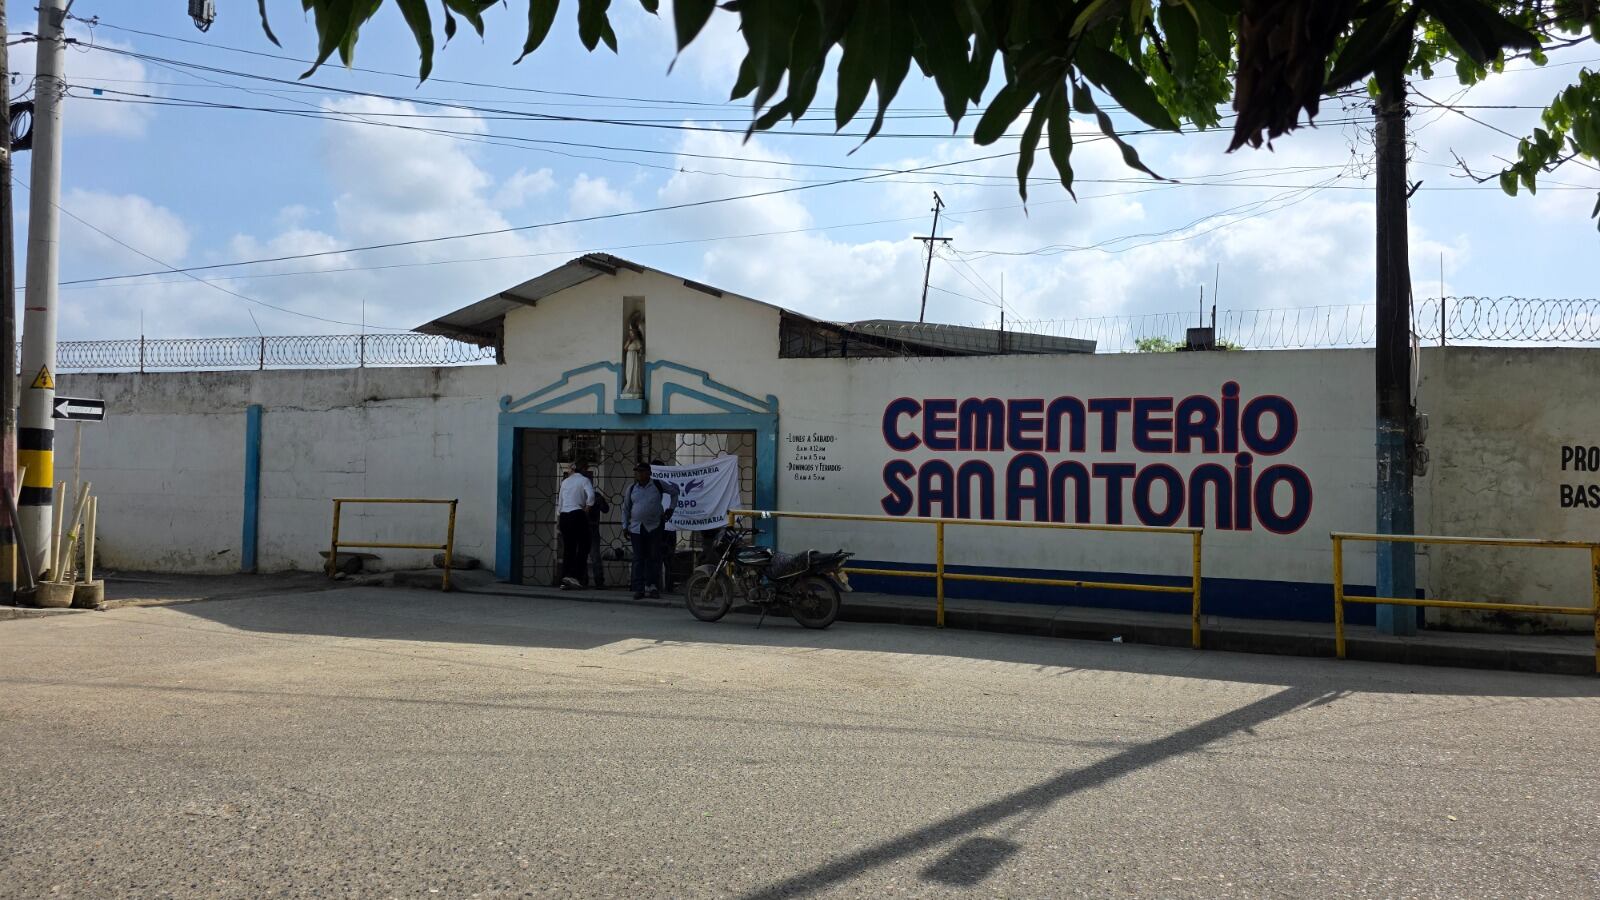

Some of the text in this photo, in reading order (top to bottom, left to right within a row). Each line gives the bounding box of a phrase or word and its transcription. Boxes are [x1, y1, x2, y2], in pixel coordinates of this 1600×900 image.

[882, 381, 1299, 456] CEMENTERIO
[1561, 445, 1600, 472] PRO
[670, 466, 720, 479] HUMANITARIA
[880, 451, 1313, 535] SAN ANTONIO
[676, 499, 697, 508] BPD
[674, 515, 725, 526] HUMANITARIA
